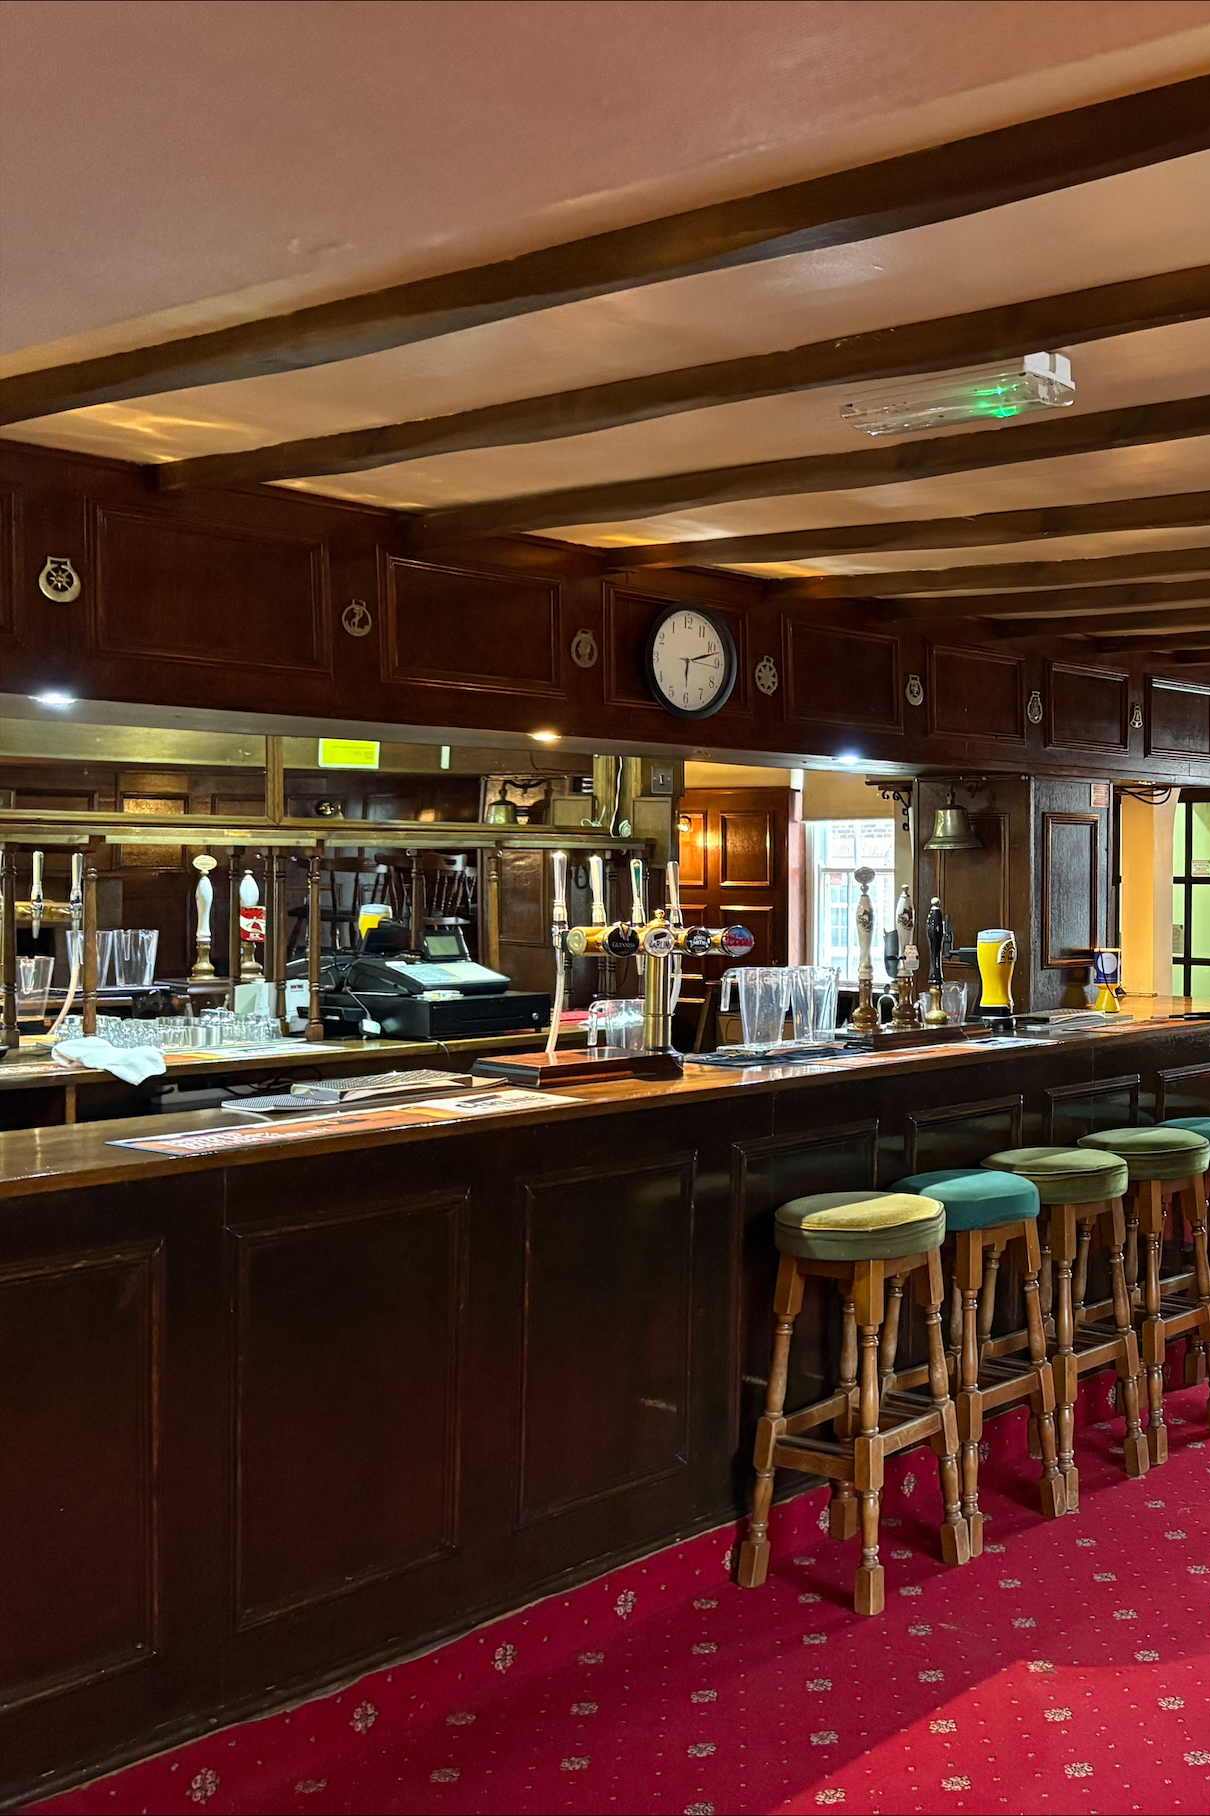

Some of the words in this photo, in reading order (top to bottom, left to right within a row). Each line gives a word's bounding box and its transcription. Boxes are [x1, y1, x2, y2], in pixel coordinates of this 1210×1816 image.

[684, 616, 693, 630] 12
[699, 625, 705, 638] 11
[659, 632, 665, 645] 2
[708, 641, 716, 653] 10
[653, 651, 659, 663] 3
[714, 658, 720, 669] 9
[709, 676, 715, 688] 8
[669, 686, 675, 698] 5
[683, 692, 689, 704] 6
[698, 688, 704, 700] 7
[611, 941, 636, 949] GUINNESS
